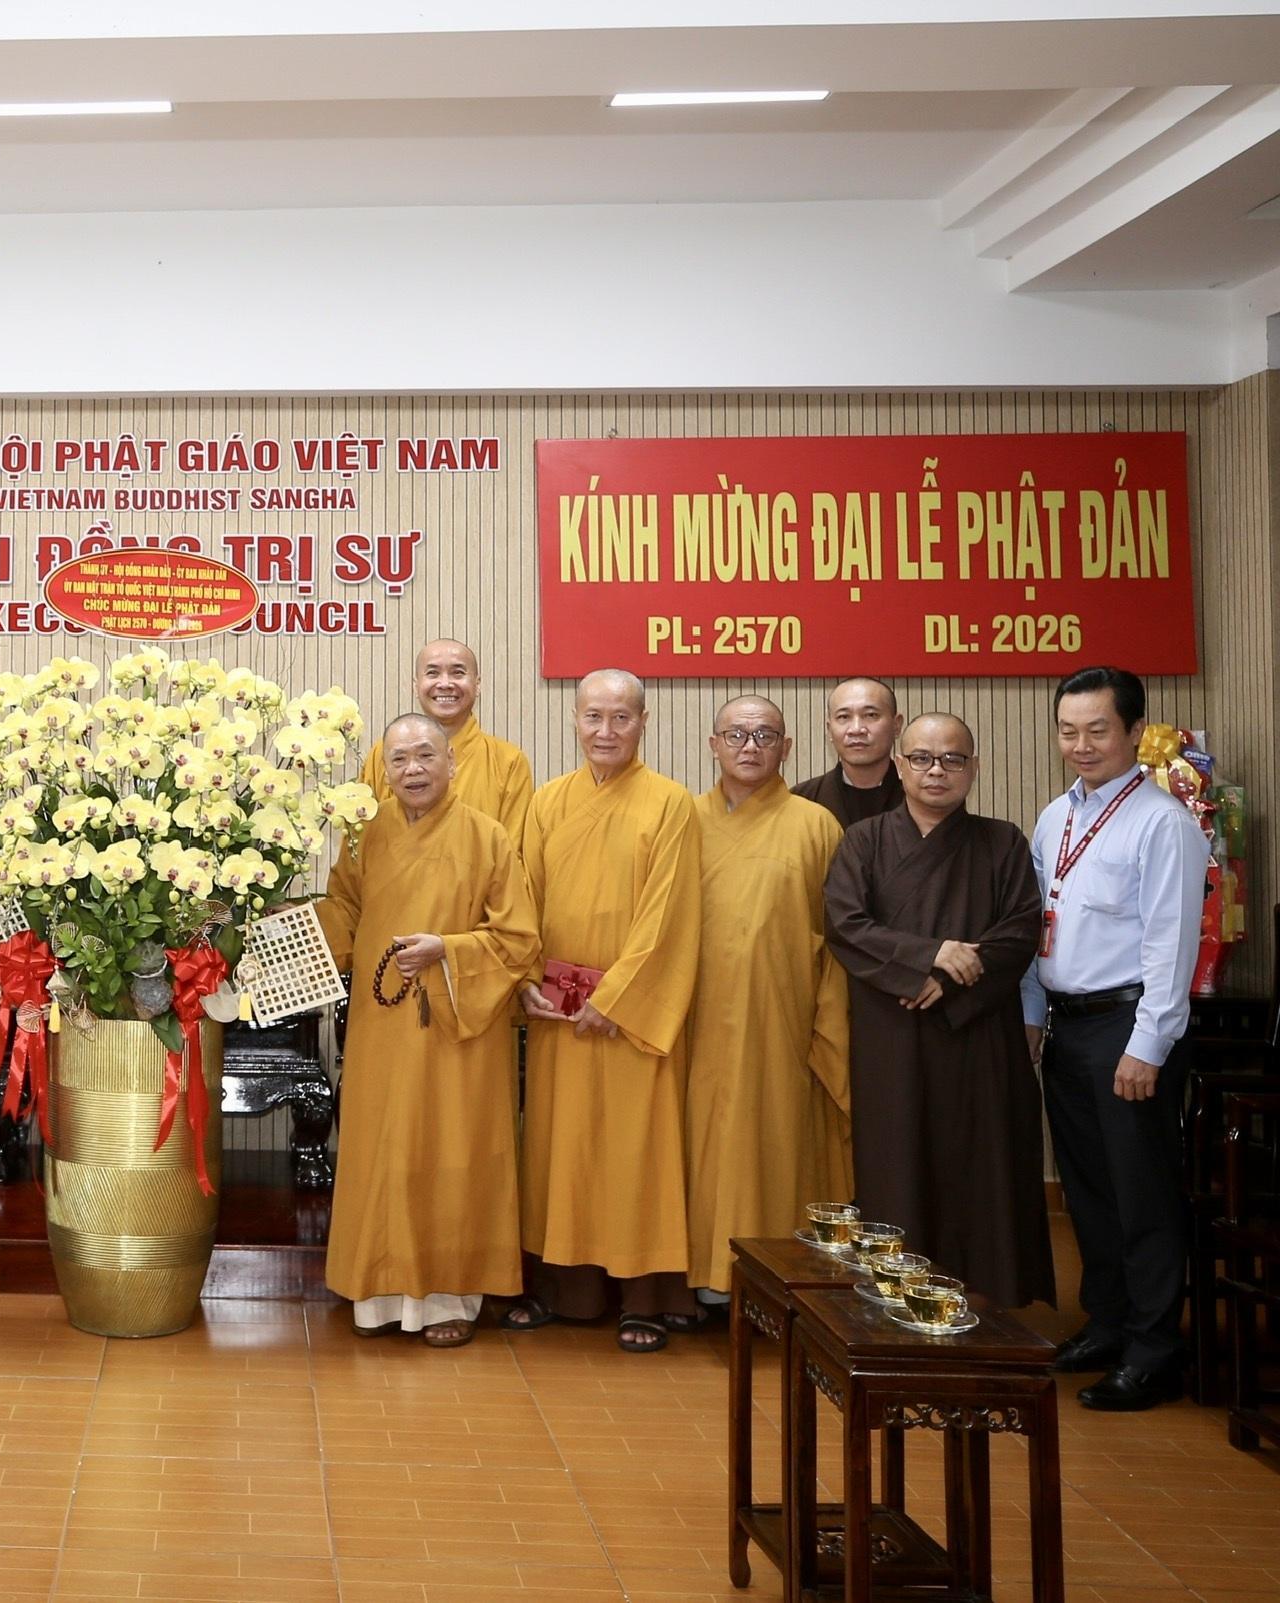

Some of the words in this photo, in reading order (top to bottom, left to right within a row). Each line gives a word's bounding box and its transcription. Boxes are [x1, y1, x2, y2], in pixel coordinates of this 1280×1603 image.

[54, 434, 168, 478] PHẬT
[178, 434, 280, 472] GIÁO
[293, 433, 385, 477] VIỆT
[398, 438, 498, 470] NAM
[114, 488, 241, 511] BUDDHIST
[250, 487, 356, 510] SANGHA
[559, 474, 658, 583] KÍNH
[673, 473, 798, 583] MỪNG
[811, 492, 881, 602] ĐẠI
[897, 456, 945, 580] LỄ
[958, 470, 1066, 601] PHẬT
[1079, 457, 1170, 579] ĐẢN
[224, 535, 313, 593] TRỊ
[335, 531, 421, 593] SỰ
[83, 596, 110, 611] CHÚC
[112, 597, 141, 612] MỪNG
[143, 600, 159, 615] ĐẠI
[175, 600, 200, 617] PHẬT
[647, 615, 701, 655] PL:
[714, 615, 802, 655] 2570
[924, 613, 979, 654] DL:
[991, 613, 1082, 654] 2026
